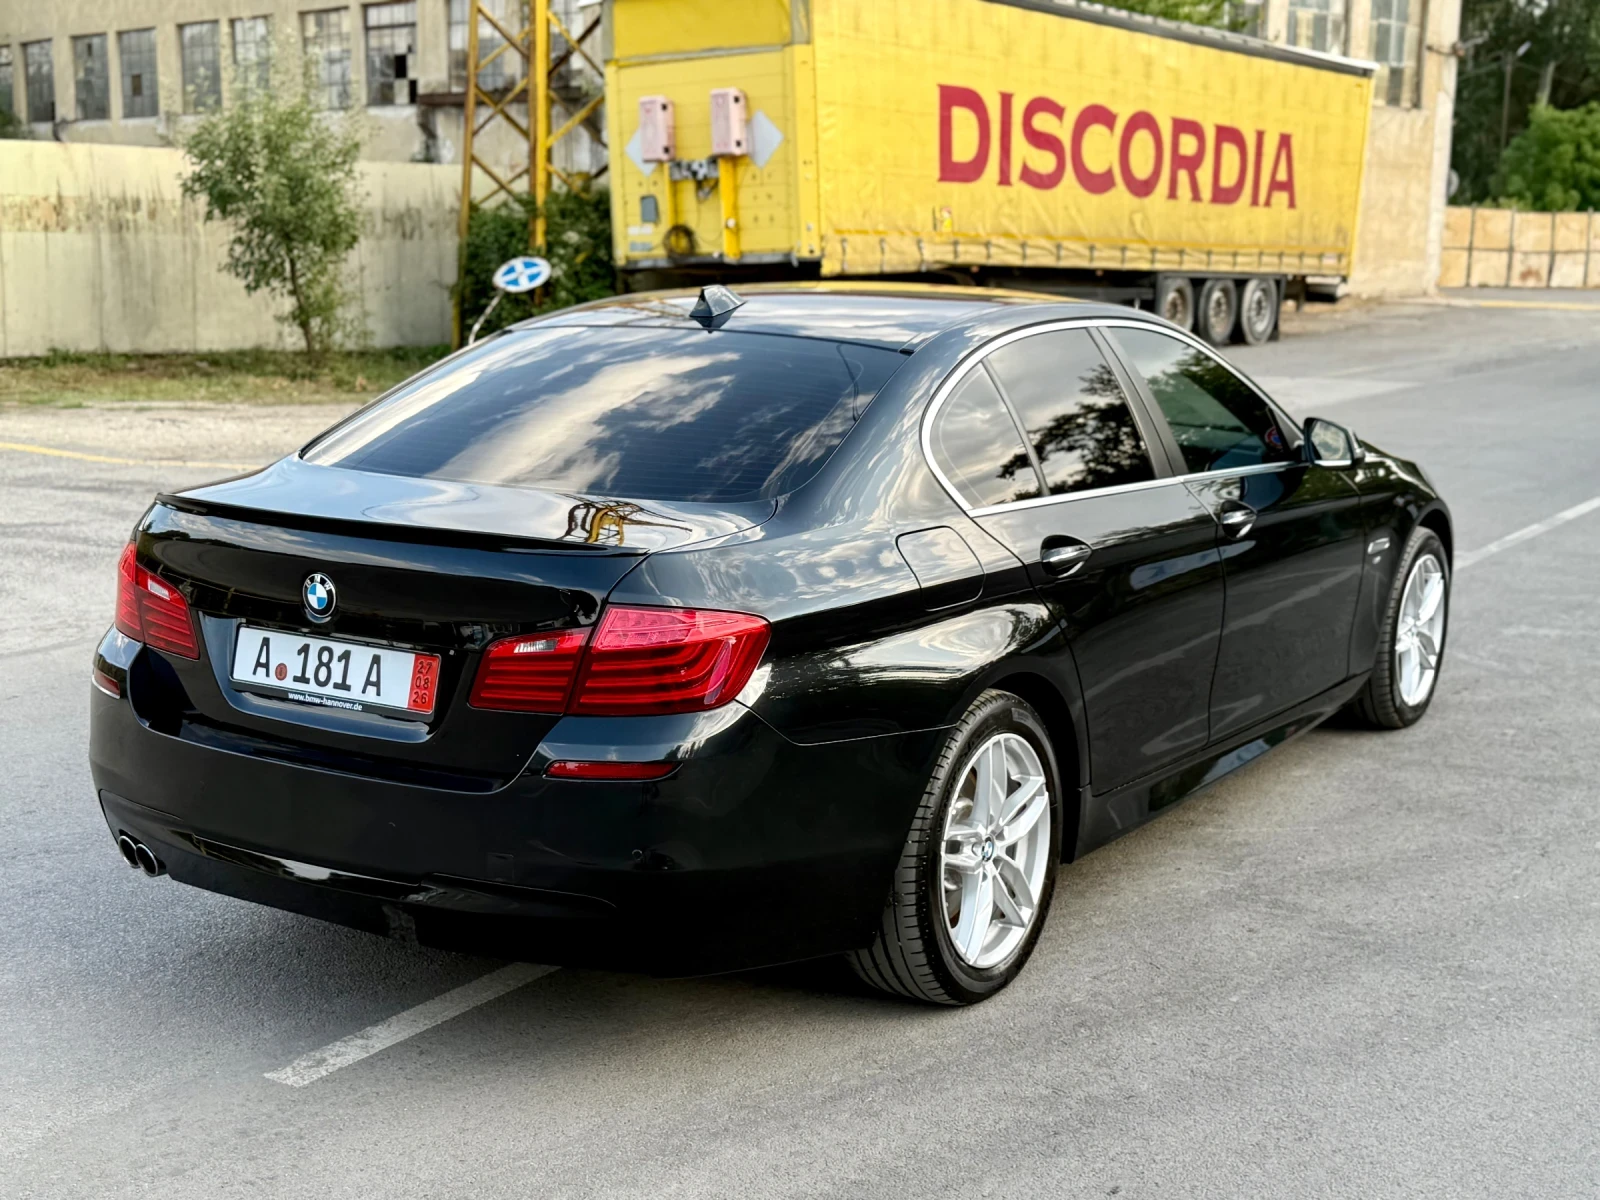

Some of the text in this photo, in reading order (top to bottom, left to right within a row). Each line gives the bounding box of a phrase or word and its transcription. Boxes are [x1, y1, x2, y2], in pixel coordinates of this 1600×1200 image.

[937, 83, 1297, 209] DISCORDIA
[304, 574, 333, 591] BMW
[252, 636, 381, 696] A 181 A
[417, 660, 433, 674] 27
[288, 692, 363, 711] www.bmw-hannover.de
